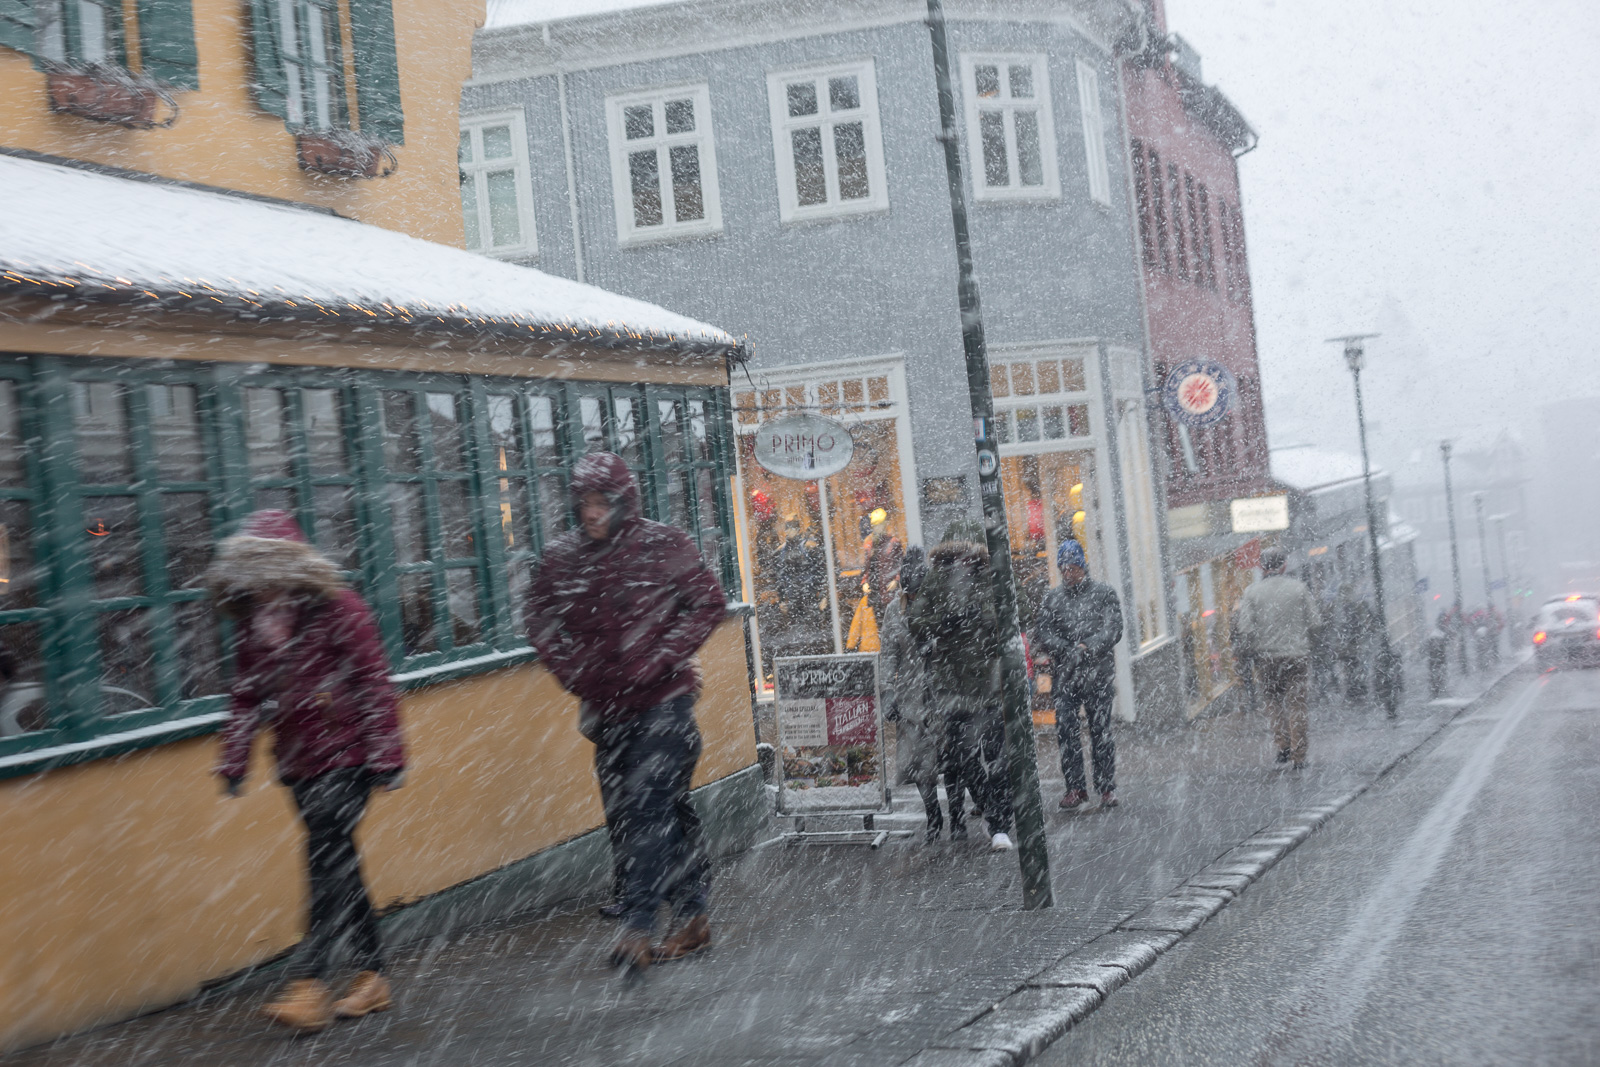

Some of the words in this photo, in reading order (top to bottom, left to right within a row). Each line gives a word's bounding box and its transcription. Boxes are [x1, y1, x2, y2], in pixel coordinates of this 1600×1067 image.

[772, 433, 834, 454] PRIMO
[801, 668, 846, 686] PRIMO
[835, 702, 869, 726] ITALIAN
